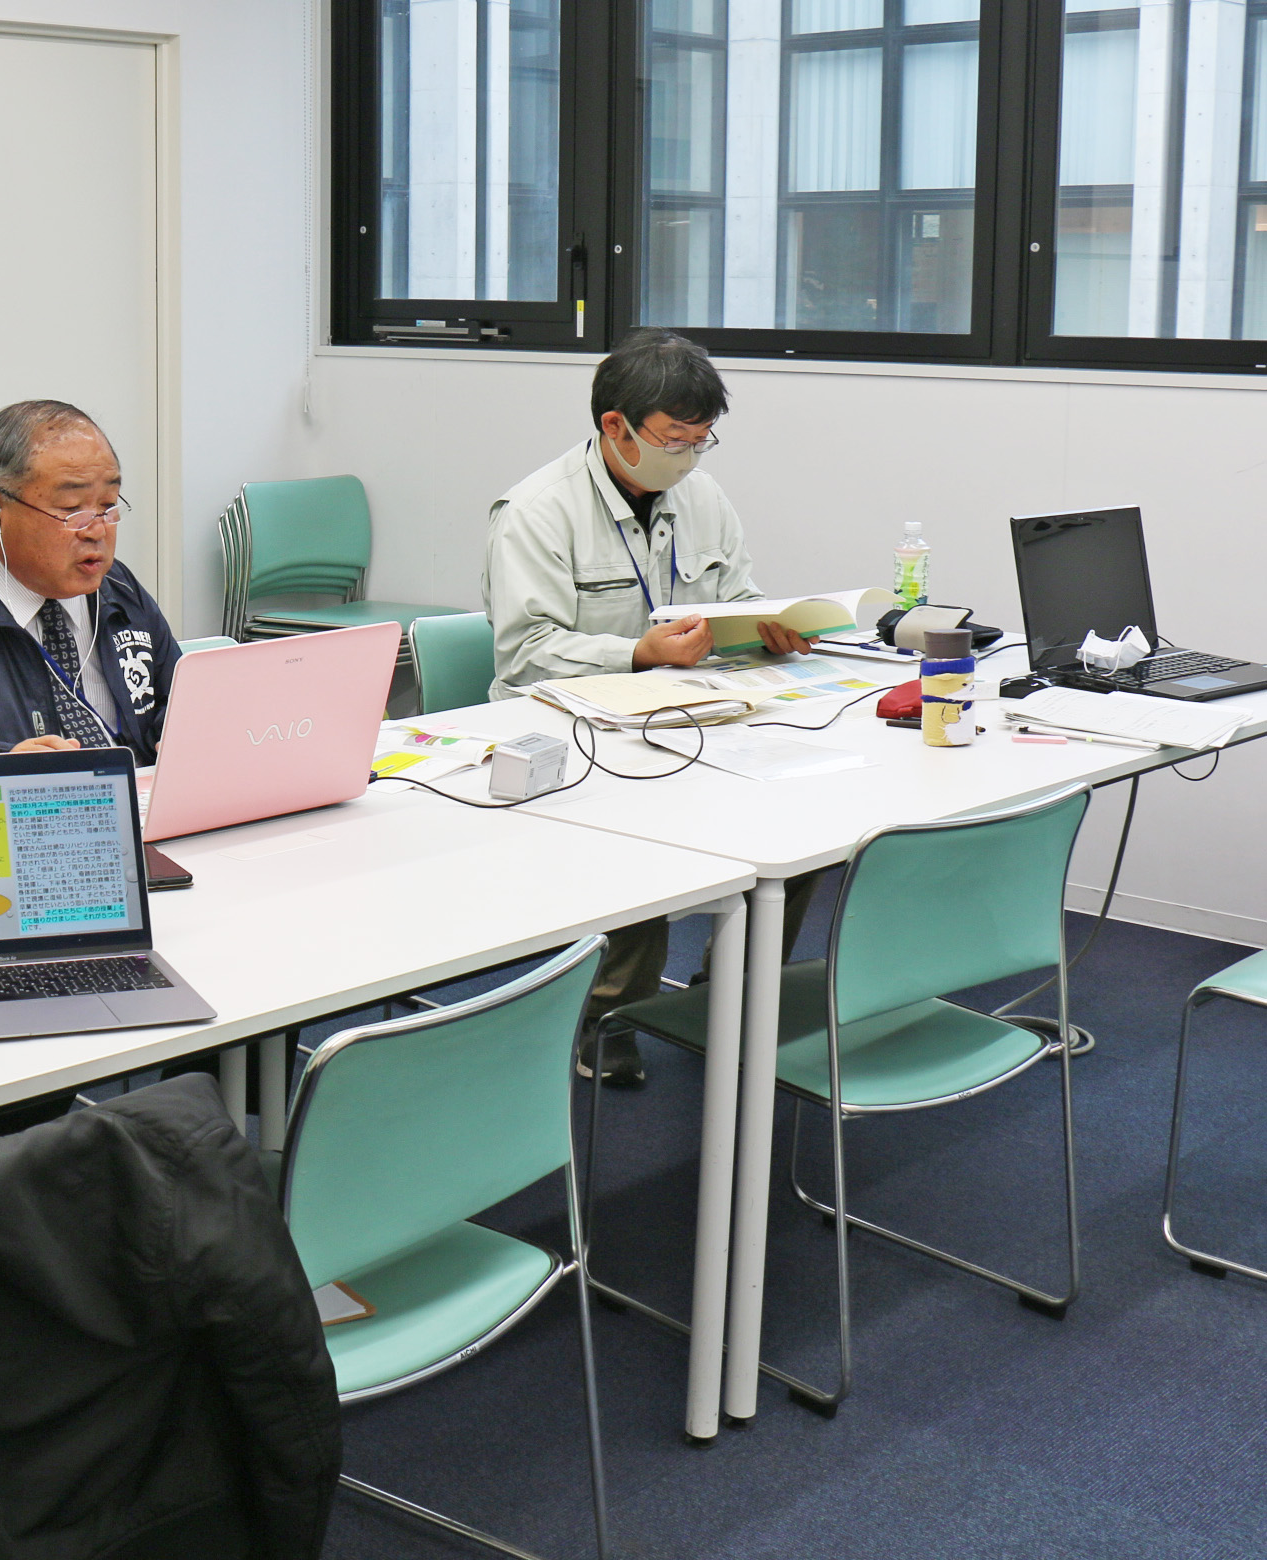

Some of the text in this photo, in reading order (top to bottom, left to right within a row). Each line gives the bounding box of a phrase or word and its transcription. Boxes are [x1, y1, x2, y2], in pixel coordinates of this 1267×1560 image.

[285, 657, 304, 665] SONY
[246, 717, 314, 746] VAIO
[459, 1345, 478, 1360] AICHI
